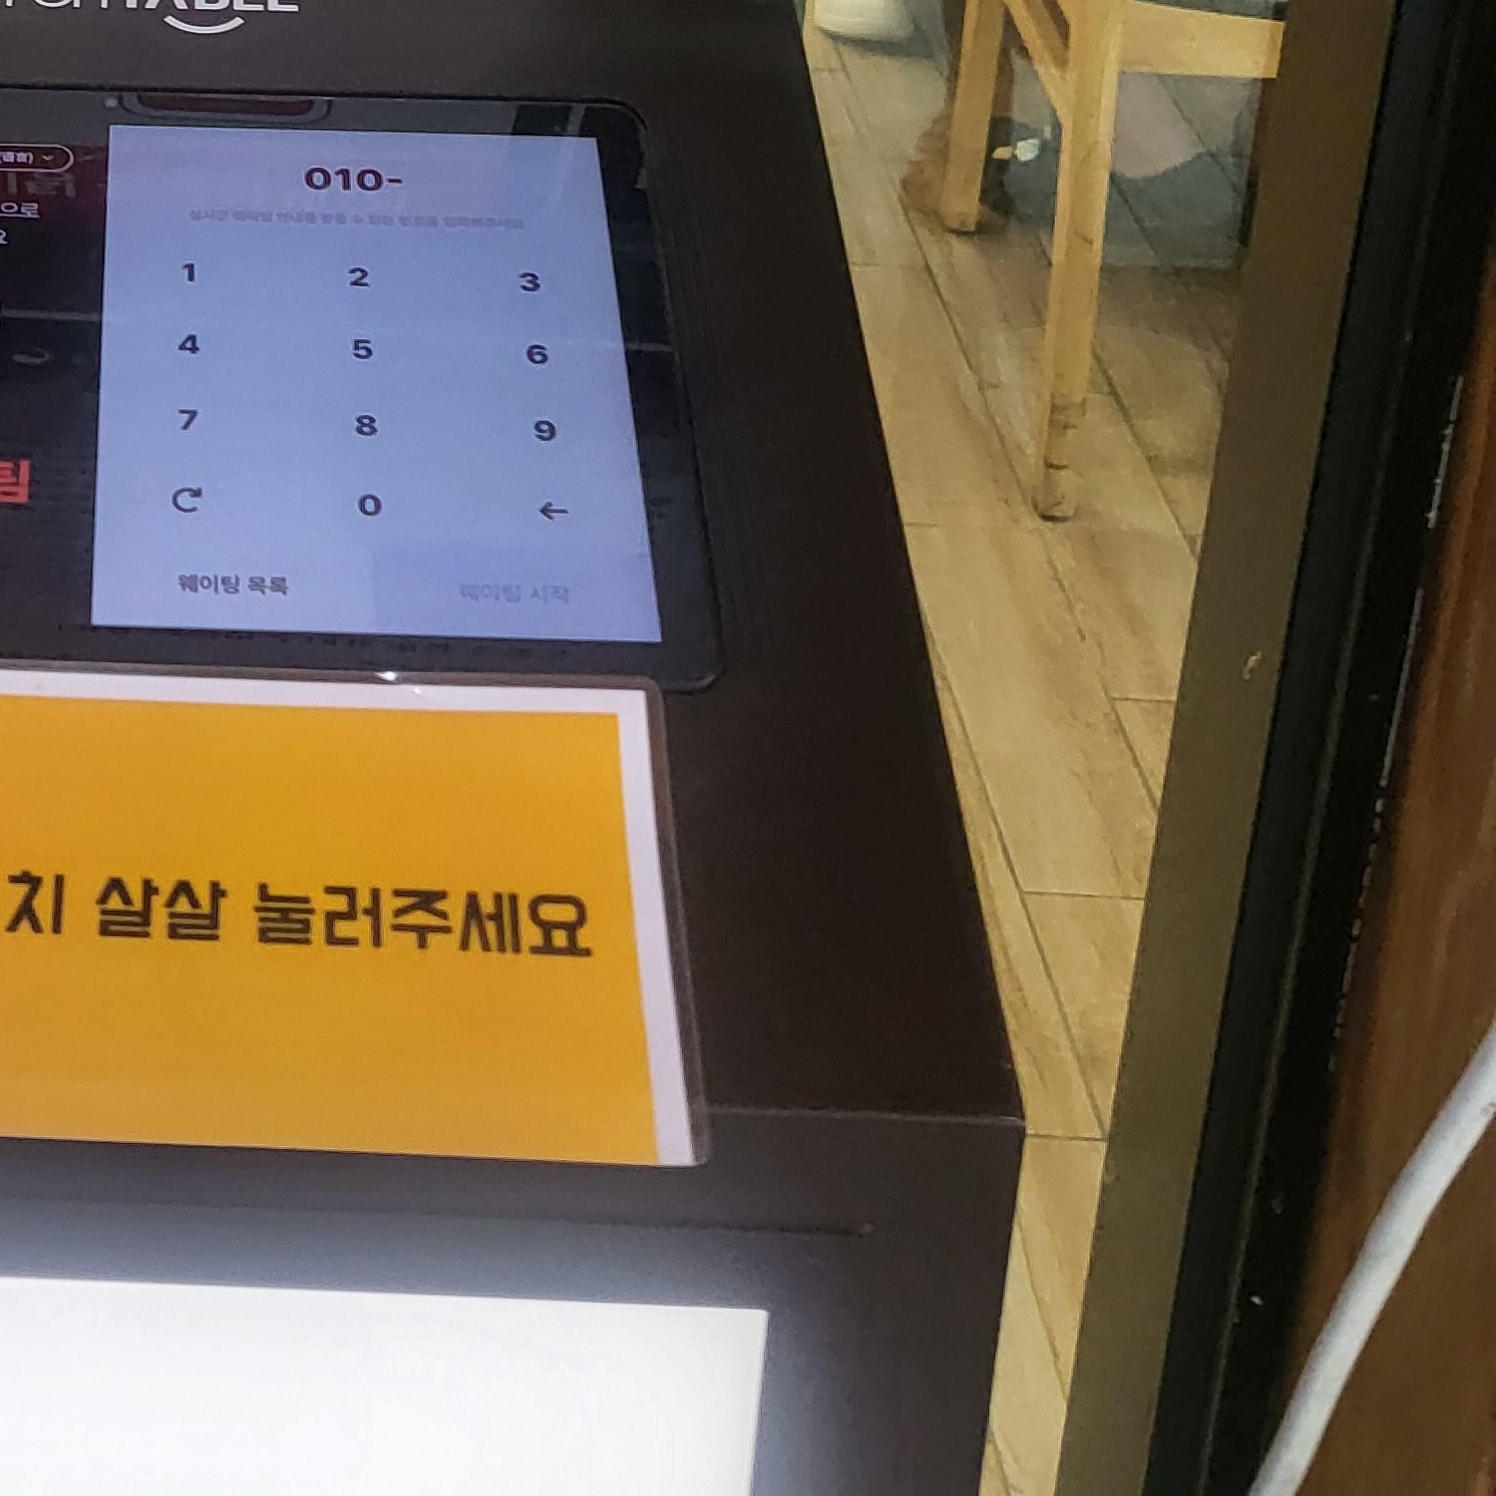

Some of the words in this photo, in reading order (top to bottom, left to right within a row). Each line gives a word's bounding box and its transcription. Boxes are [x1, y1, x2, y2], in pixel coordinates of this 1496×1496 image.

[304, 166, 403, 192] 010-
[181, 262, 195, 282] 1
[348, 266, 369, 287] 2
[518, 272, 541, 292] 3
[178, 334, 199, 355] 4
[352, 338, 373, 360] 5
[526, 344, 549, 364] 6
[178, 408, 198, 430] 7
[355, 414, 377, 436] 8
[533, 419, 556, 442] 9
[357, 494, 382, 517] 0
[178, 573, 240, 596] 웨이팅
[248, 574, 290, 597] 목록
[96, 876, 228, 942] 살살
[253, 882, 593, 957] 눌러주세요
